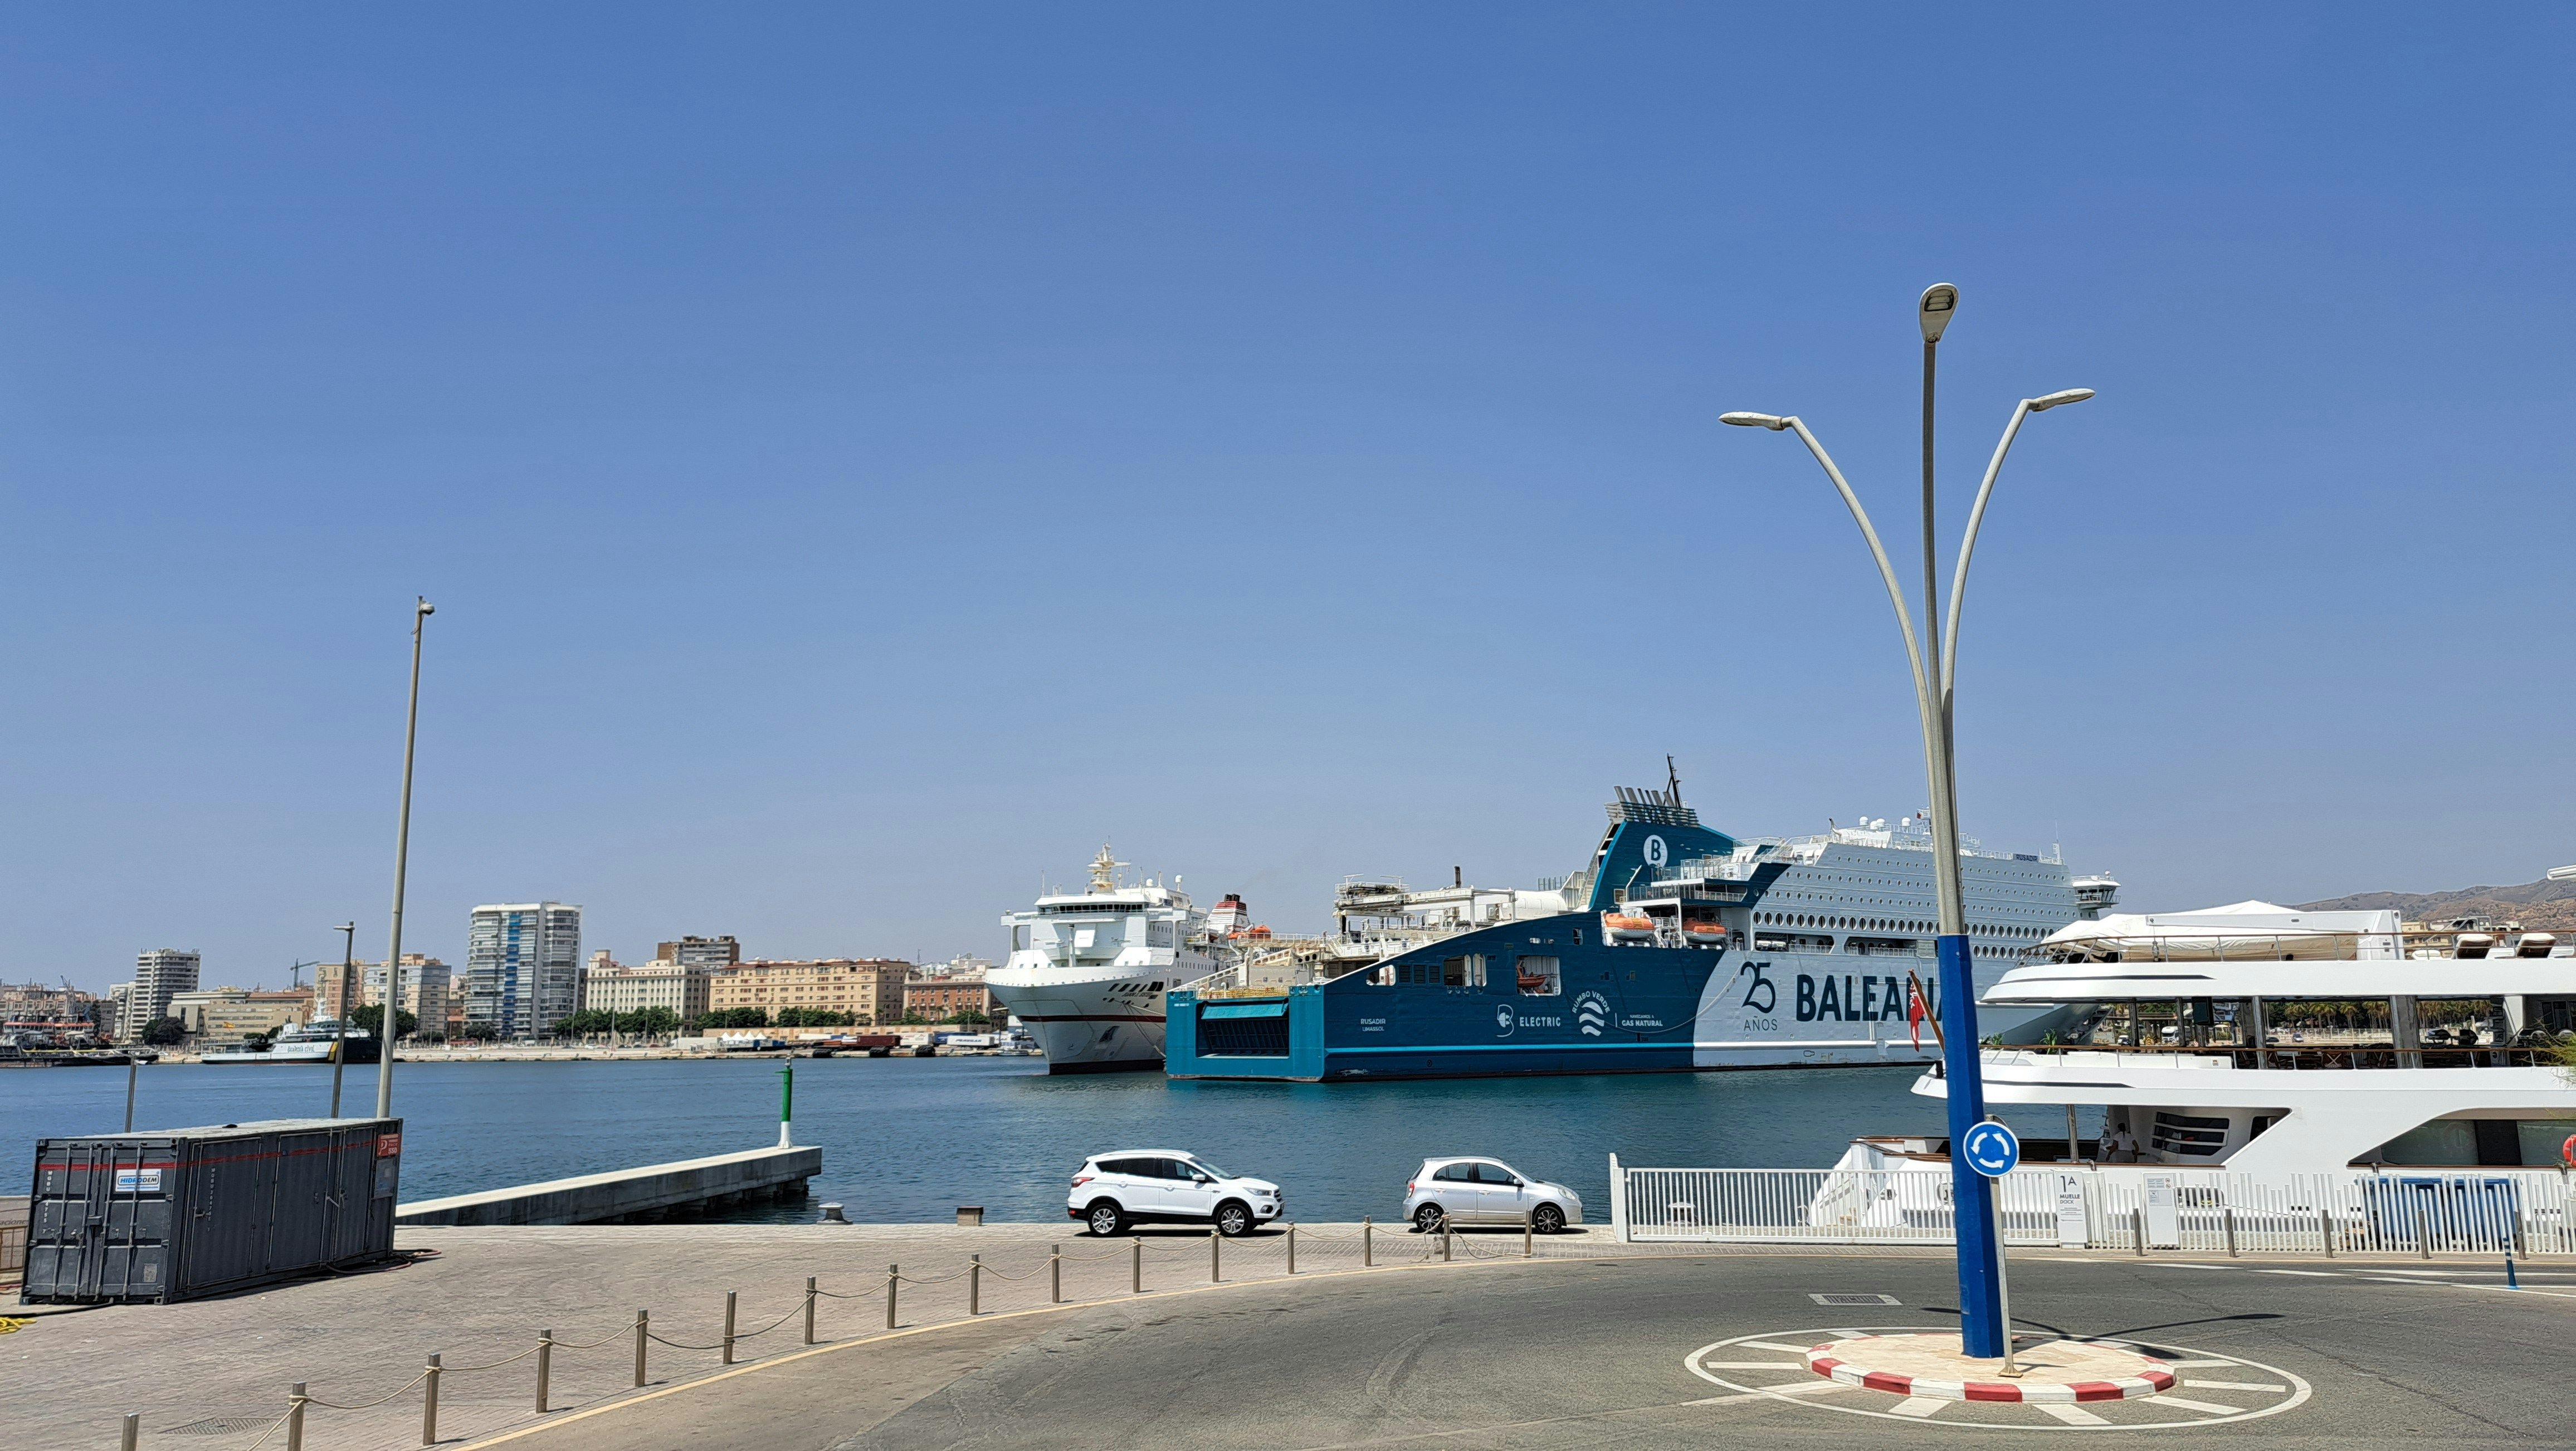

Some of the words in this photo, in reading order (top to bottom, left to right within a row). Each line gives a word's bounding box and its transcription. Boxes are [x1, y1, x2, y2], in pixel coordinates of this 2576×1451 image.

[1651, 839, 1661, 861] B
[1740, 961, 1776, 1014] 25
[1572, 990, 1591, 1014] RUMBO
[1592, 990, 1611, 1014] VERDE
[1519, 1016, 1561, 1027] ELECTRIC
[1744, 1015, 1778, 1031] AÑOS
